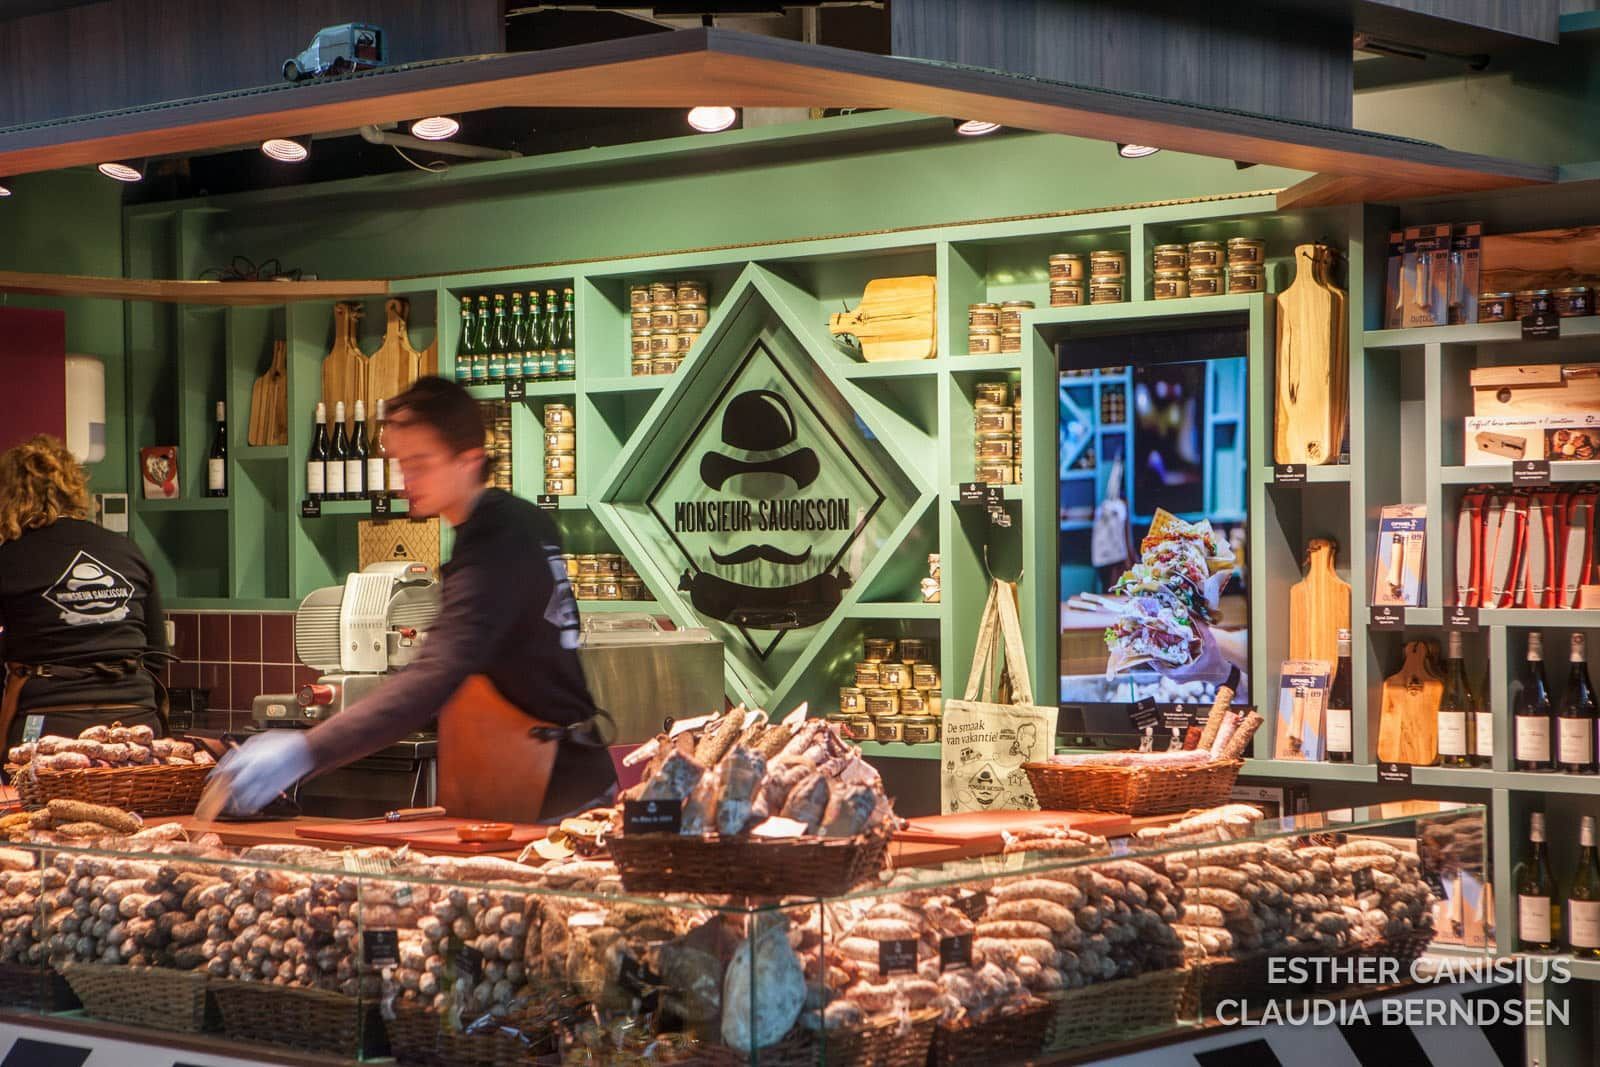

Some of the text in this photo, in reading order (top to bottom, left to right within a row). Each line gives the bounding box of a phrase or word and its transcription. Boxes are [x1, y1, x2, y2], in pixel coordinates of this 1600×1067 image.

[675, 498, 850, 532] MONSIEUR SAUCISSON
[947, 720, 985, 733] De smaak
[946, 736, 960, 745] van
